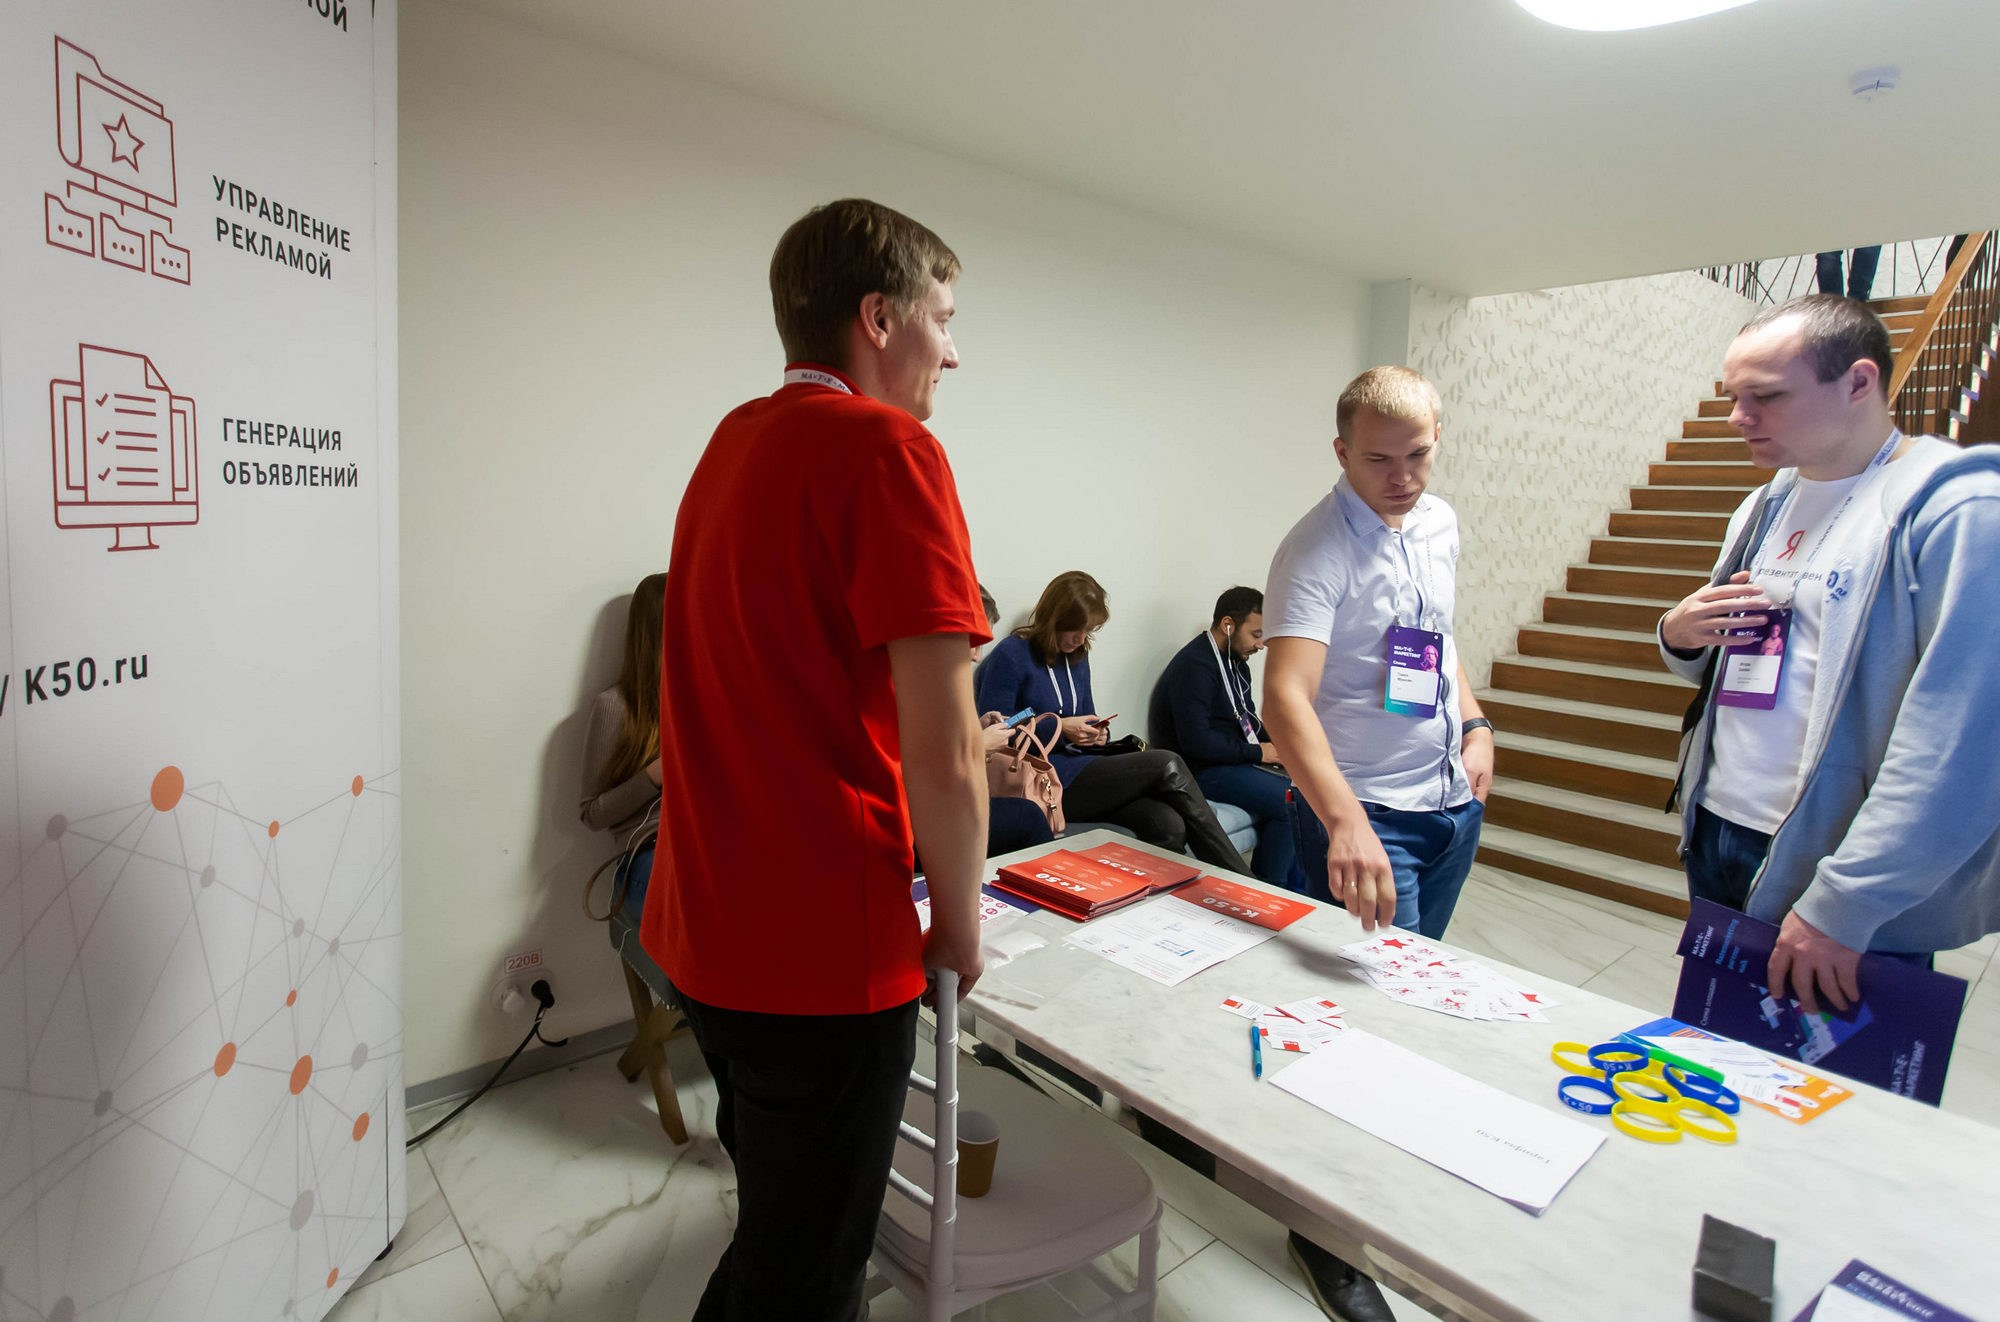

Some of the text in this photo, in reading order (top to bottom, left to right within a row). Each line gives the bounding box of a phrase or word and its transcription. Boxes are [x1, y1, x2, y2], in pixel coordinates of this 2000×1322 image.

[308, 0, 347, 32] ОЙ
[212, 174, 351, 252] УПРАВЛЕНИЕ
[215, 217, 332, 280] РЕКЛАМОЙ
[222, 417, 342, 454] ГЕНЕРАЦИЯ
[222, 460, 359, 488] ОБЪЯВЛЕНИЙ
[1776, 529, 1806, 561] Я
[25, 654, 148, 705] K50.ru
[507, 953, 541, 970] 220В
